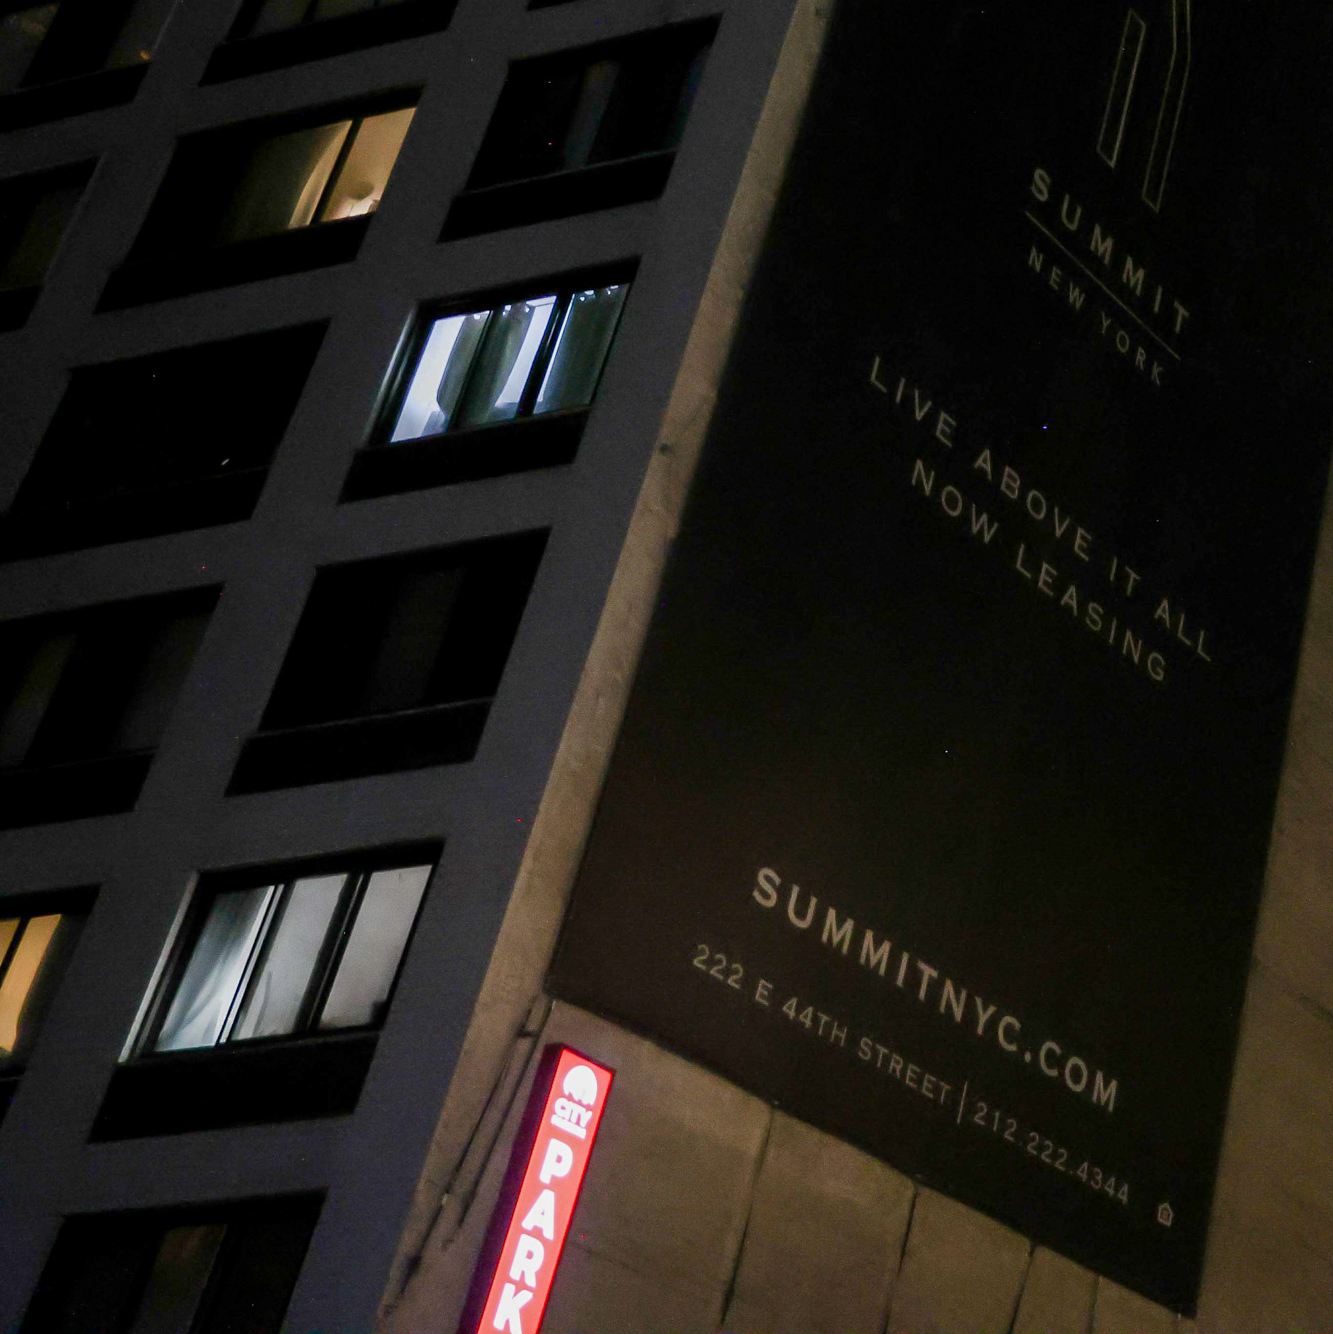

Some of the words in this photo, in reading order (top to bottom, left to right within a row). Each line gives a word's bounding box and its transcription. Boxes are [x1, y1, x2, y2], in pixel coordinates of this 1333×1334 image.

[1027, 245, 1085, 311] NEW
[1099, 311, 1163, 387] YORK
[1029, 167, 1190, 335] SUMMIT
[869, 355, 956, 448] LIVE
[973, 448, 1092, 561] ABOVE
[1109, 556, 1140, 598] IT
[1153, 597, 1212, 663] ALL
[911, 459, 999, 545] NOW
[1015, 543, 1166, 682] LEASING
[692, 944, 744, 990] 222
[754, 978, 774, 1006] E
[782, 997, 847, 1048] 44TH
[858, 1037, 951, 1106] STREET
[973, 1102, 1130, 1205] 212.222.4344
[752, 866, 1119, 1114] SUMMITNYC.COM
[554, 1097, 592, 1128] CITY
[493, 1138, 574, 1334] PARK
